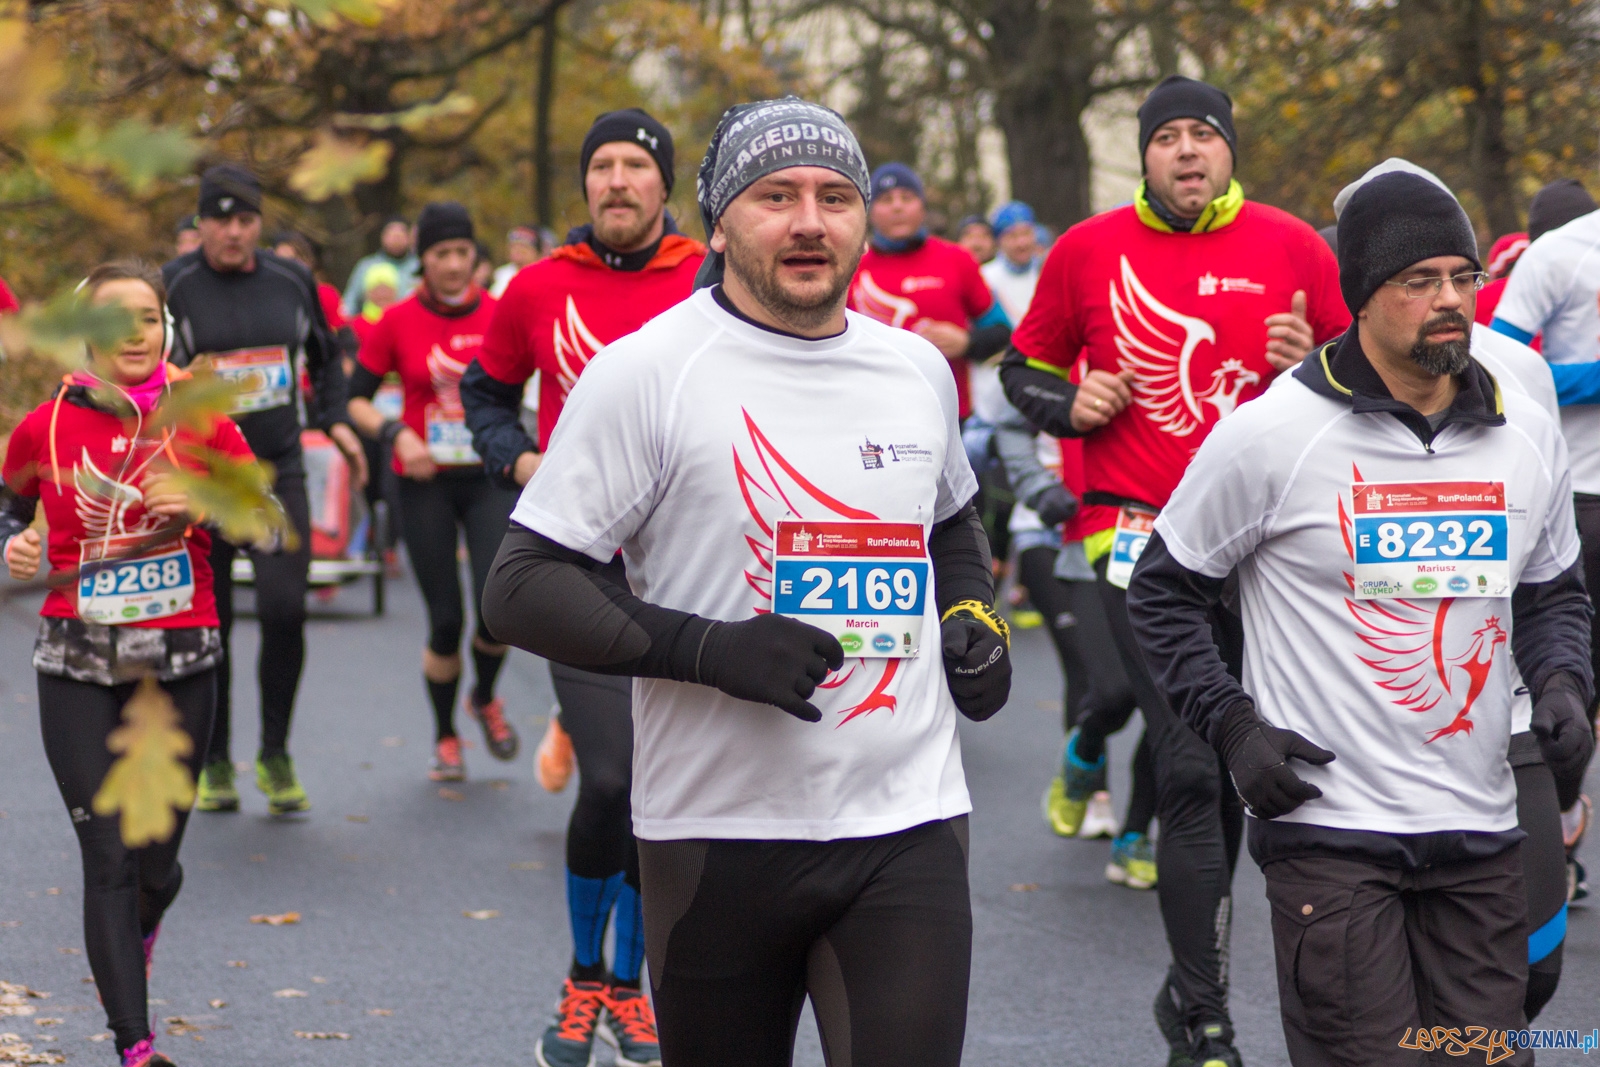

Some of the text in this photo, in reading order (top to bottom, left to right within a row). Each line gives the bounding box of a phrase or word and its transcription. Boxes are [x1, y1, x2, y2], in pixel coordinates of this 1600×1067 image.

[759, 143, 854, 167] FINISHER
[888, 444, 900, 462] 1
[1386, 493, 1394, 507] 1
[1437, 493, 1497, 504] RunPoland.org
[816, 533, 824, 548] 1
[867, 537, 920, 550] RunPoland.org
[1359, 519, 1493, 559] E 8232
[1417, 564, 1457, 573] Mariusz
[94, 558, 181, 595] 9268
[780, 567, 918, 611] E 2169
[1363, 580, 1389, 588] GRUPA
[1363, 587, 1394, 595] LUXMED
[846, 618, 879, 629] Marcin
